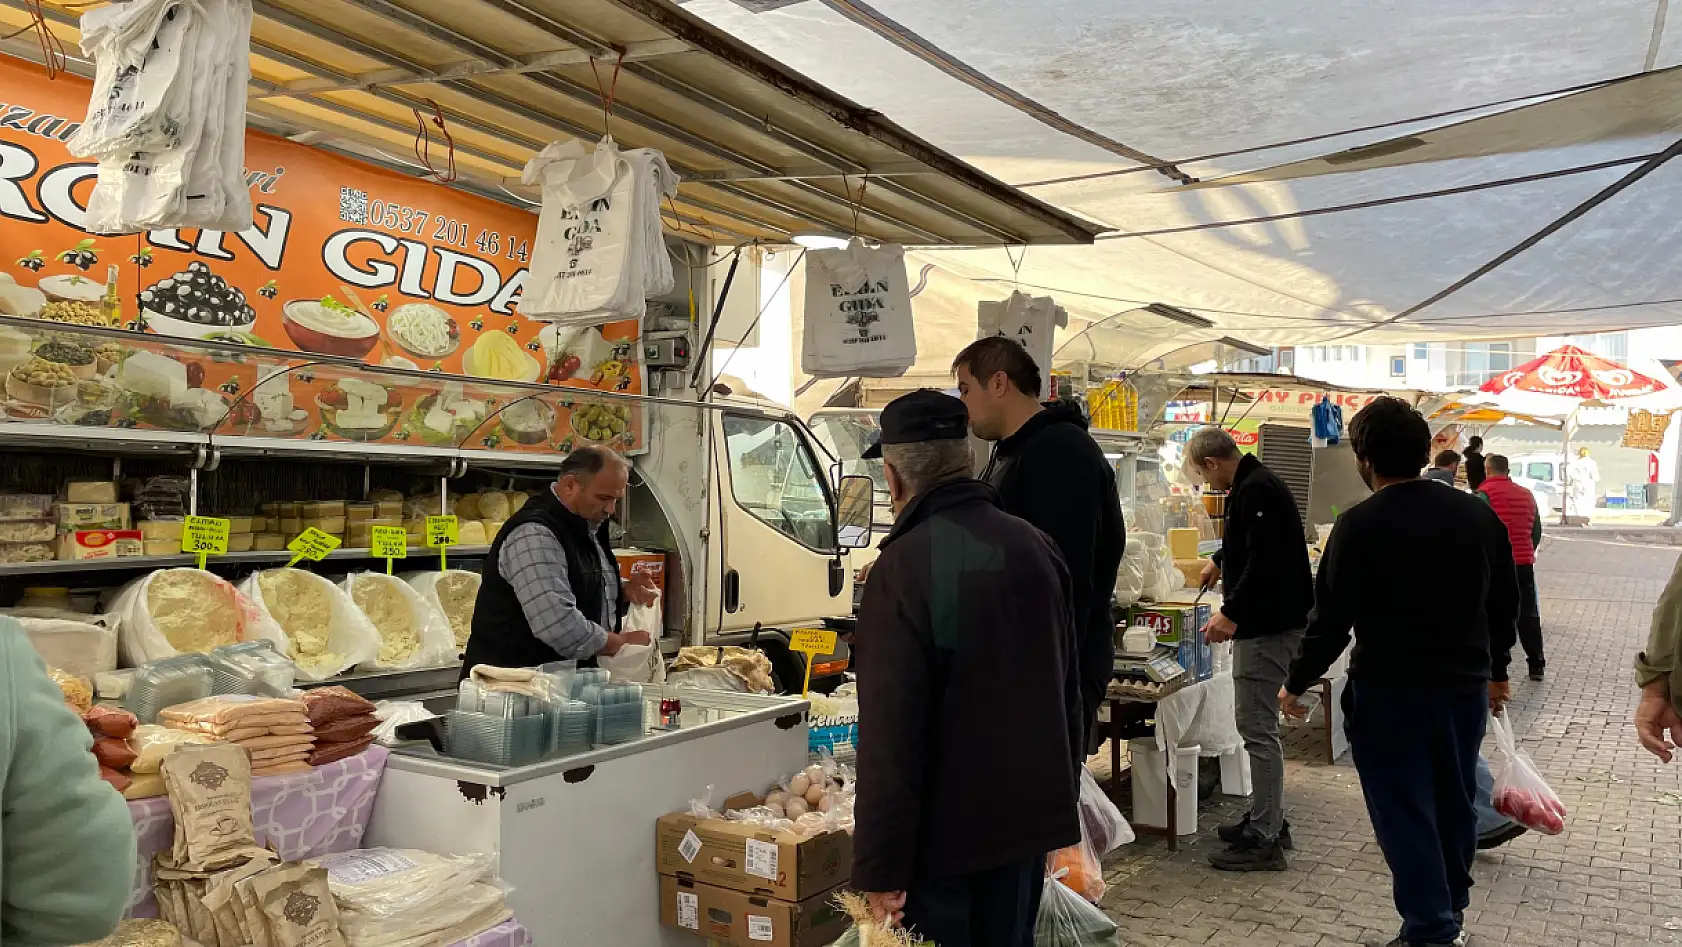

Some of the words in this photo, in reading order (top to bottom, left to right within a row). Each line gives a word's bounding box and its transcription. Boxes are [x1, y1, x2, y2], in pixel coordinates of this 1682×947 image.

[369, 199, 429, 236] 0537
[433, 216, 469, 248] 201
[475, 228, 501, 255] 46
[506, 236, 529, 262] 14
